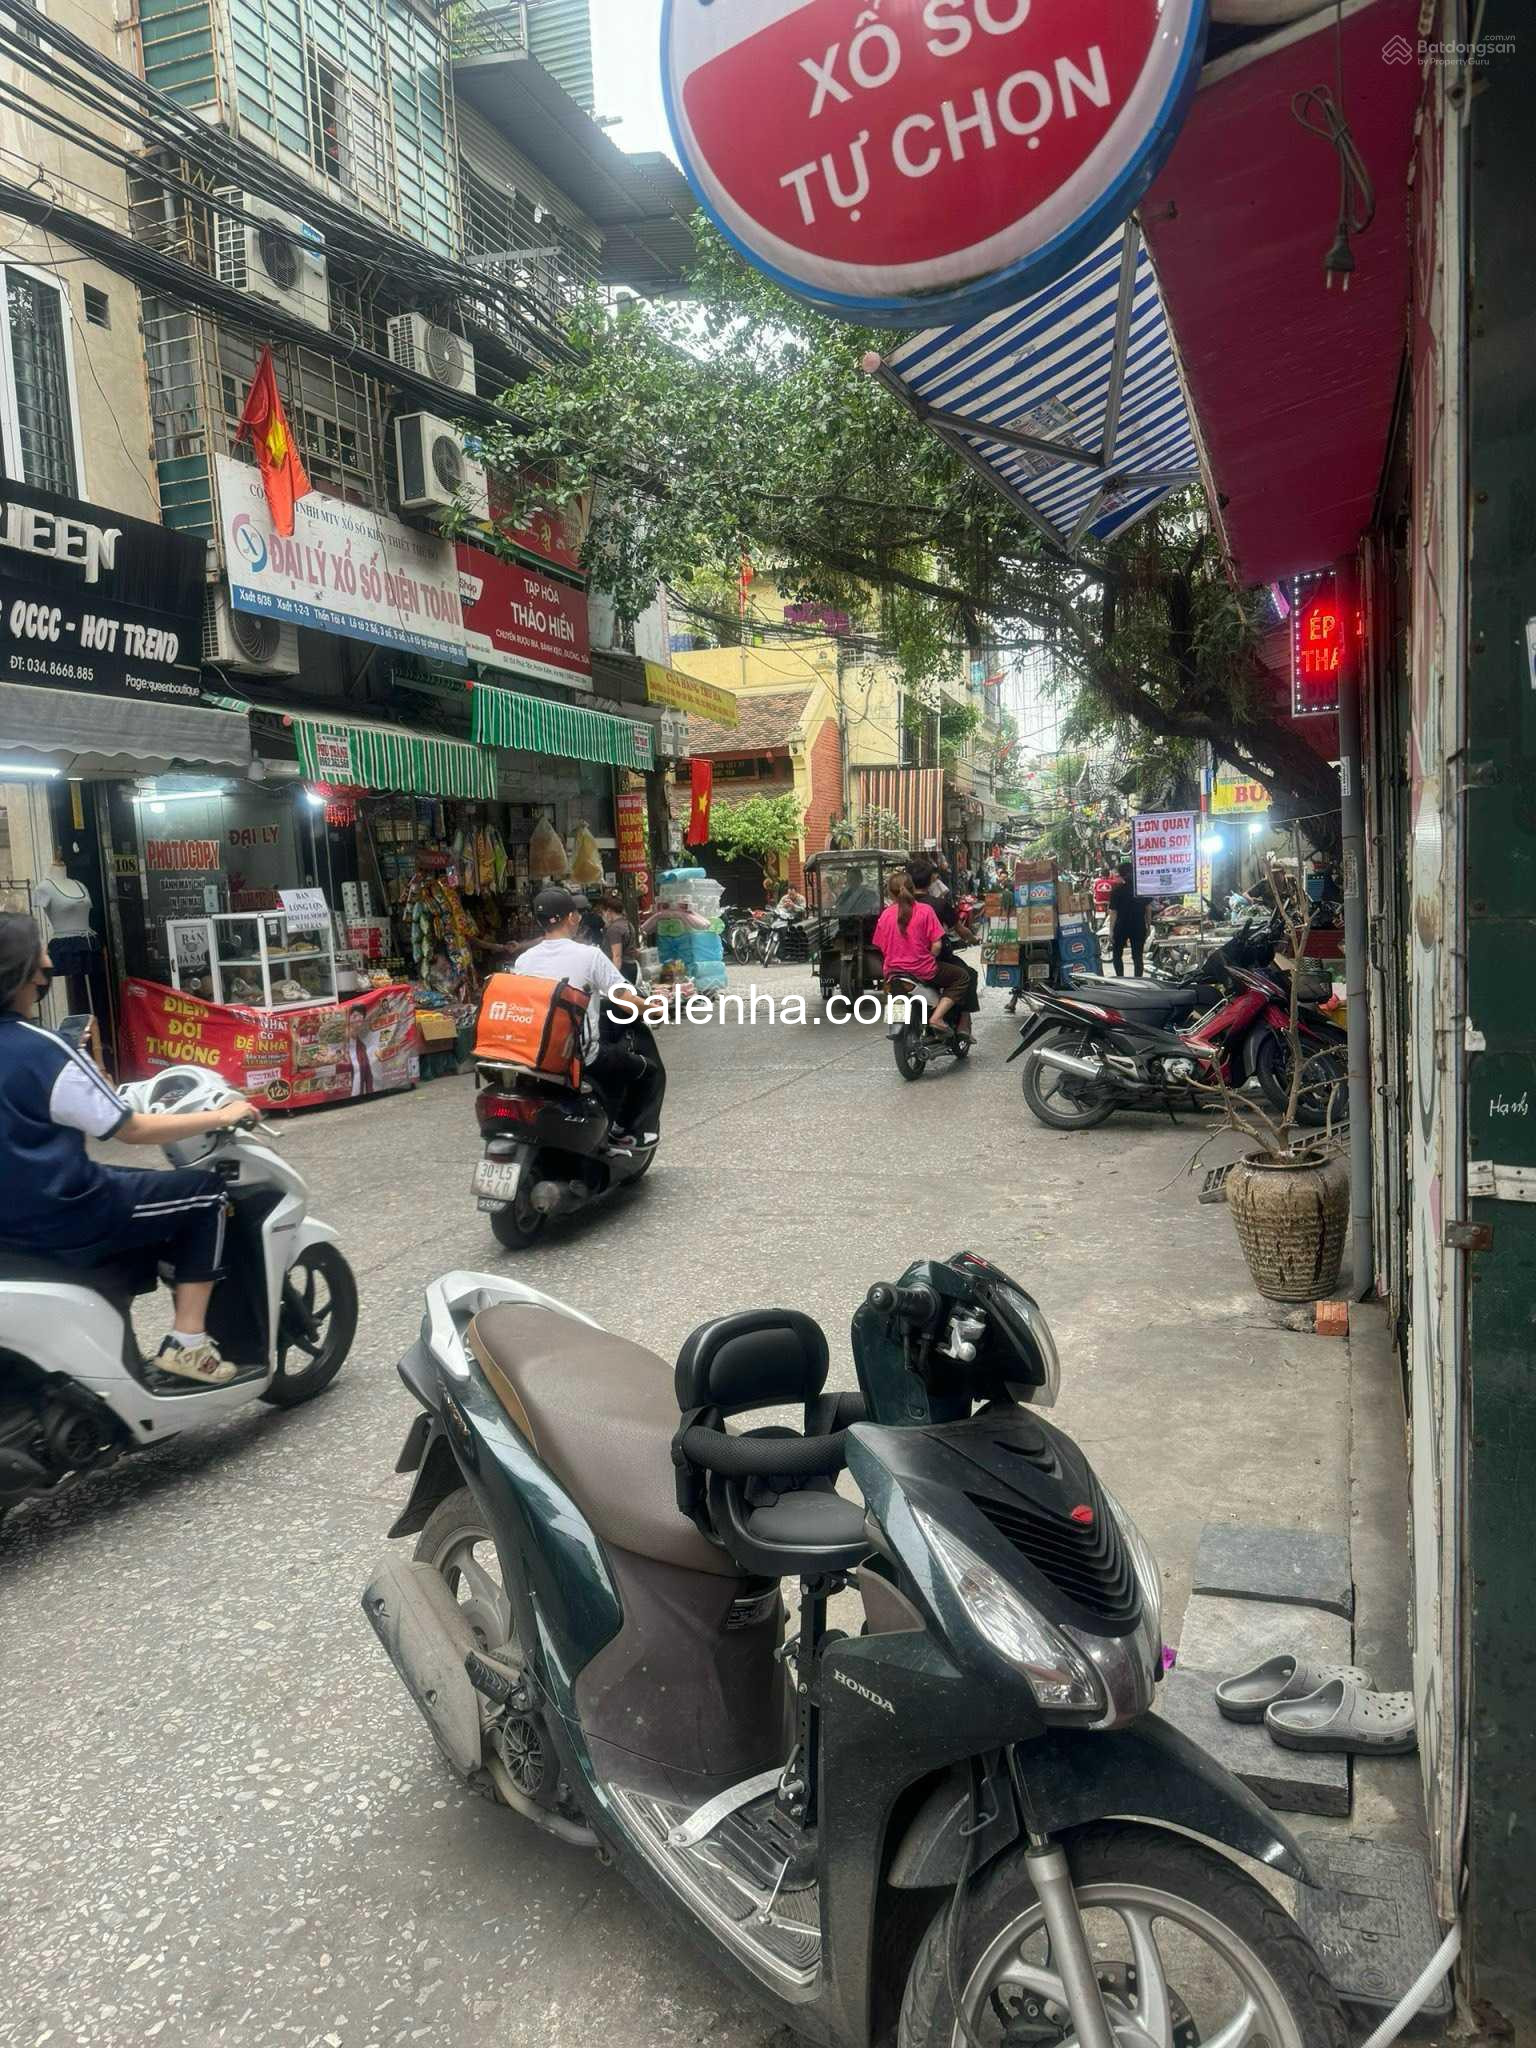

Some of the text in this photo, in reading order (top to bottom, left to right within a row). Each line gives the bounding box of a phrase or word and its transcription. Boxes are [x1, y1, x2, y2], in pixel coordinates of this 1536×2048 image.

[779, 45, 1112, 227] TỰ CHỌN
[321, 511, 339, 527] MTV
[268, 533, 461, 626] ĐẠI LÝ XỔ SỐ ĐIỆN TOÁN
[523, 578, 560, 605] TẠP HÓA
[10, 600, 62, 642] QCCC
[80, 614, 120, 653] HOT
[123, 623, 179, 664] TREND
[510, 600, 547, 633] THẢO
[1309, 608, 1336, 641] ÉP
[9, 655, 94, 682] ĐT: 034.8668.885
[229, 829, 257, 848] ĐẠI
[1162, 817, 1191, 834] QUAY
[146, 840, 220, 871] PHOTOCOPY
[167, 1016, 203, 1040] ĐỔI
[506, 1010, 533, 1025] Food
[146, 1036, 220, 1067] THƯỞNG
[833, 1667, 896, 1714] HONDA
